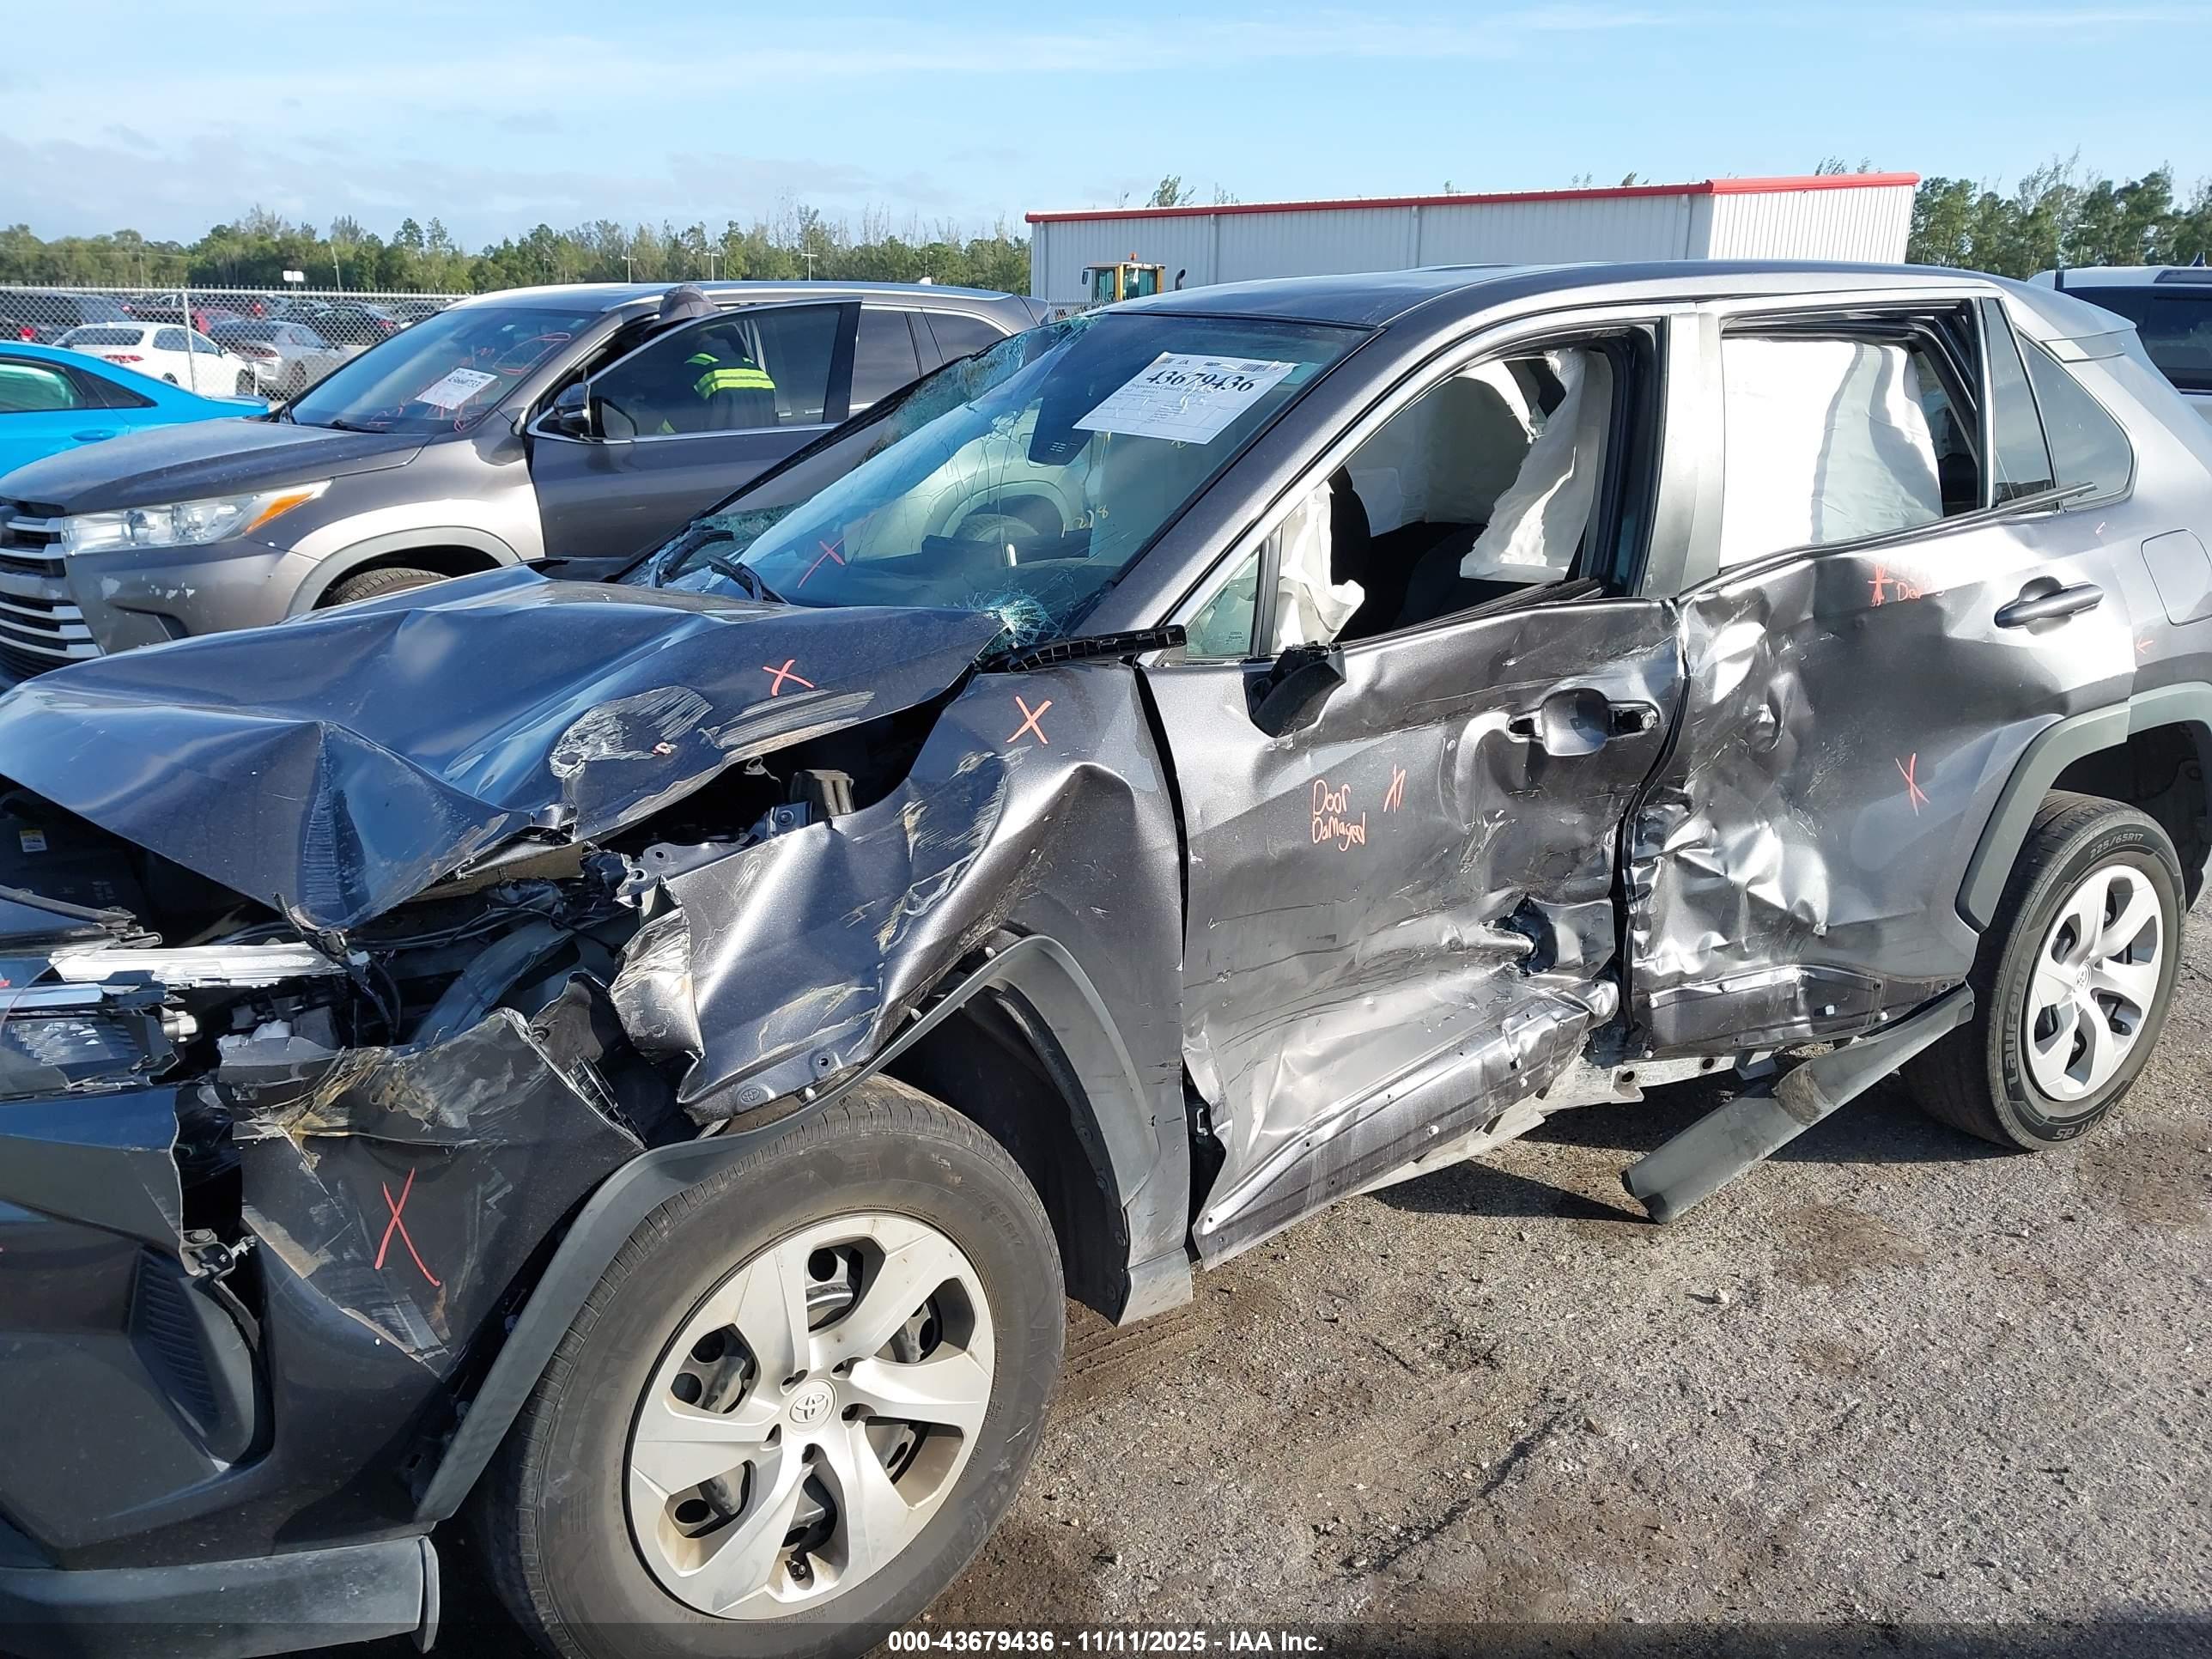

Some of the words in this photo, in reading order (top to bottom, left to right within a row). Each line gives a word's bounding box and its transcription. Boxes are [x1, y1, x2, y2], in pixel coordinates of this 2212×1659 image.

[1146, 370, 1264, 392] 43679436
[1312, 779, 1352, 817] Door
[2089, 832, 2144, 860] 225/65R17
